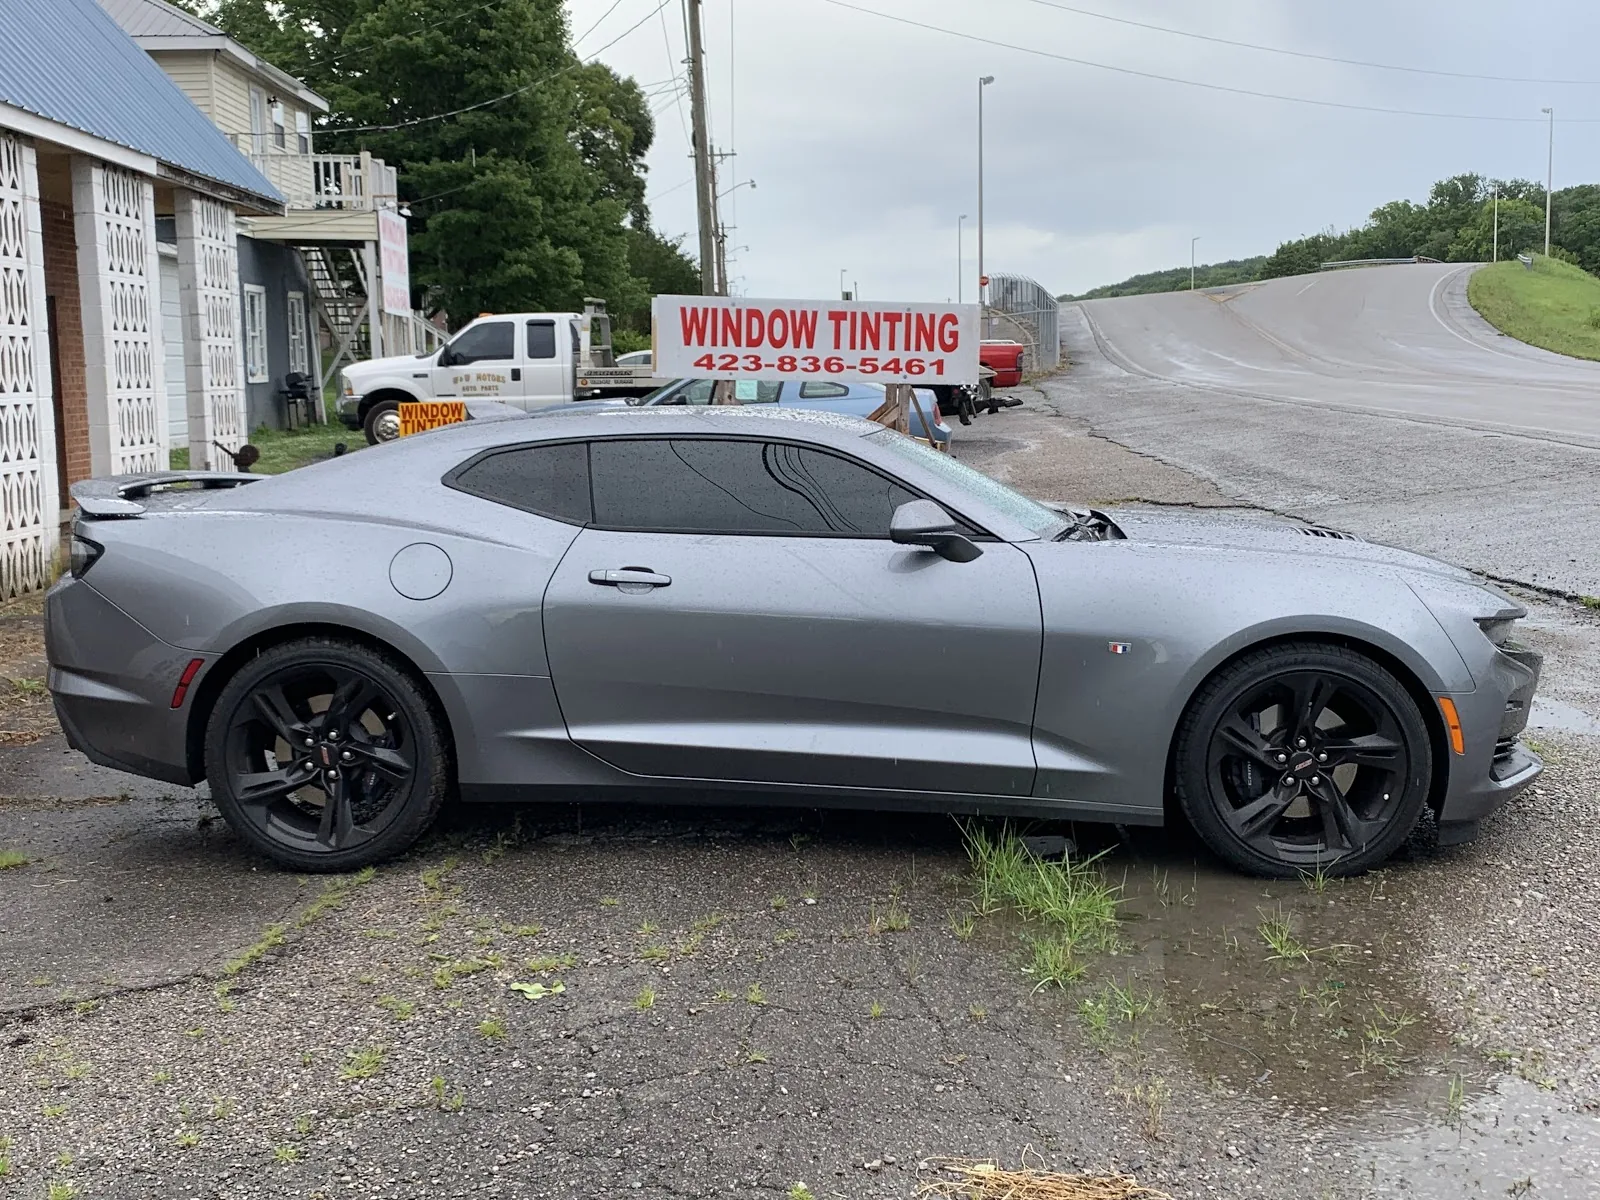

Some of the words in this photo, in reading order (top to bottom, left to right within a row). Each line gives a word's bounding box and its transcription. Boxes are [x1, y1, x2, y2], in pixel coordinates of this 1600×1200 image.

[680, 306, 819, 349] WINDOW
[828, 311, 959, 353] TINTING
[693, 353, 945, 376] 423-836-5461
[476, 373, 506, 384] MOTORS
[401, 403, 463, 419] WINDOW
